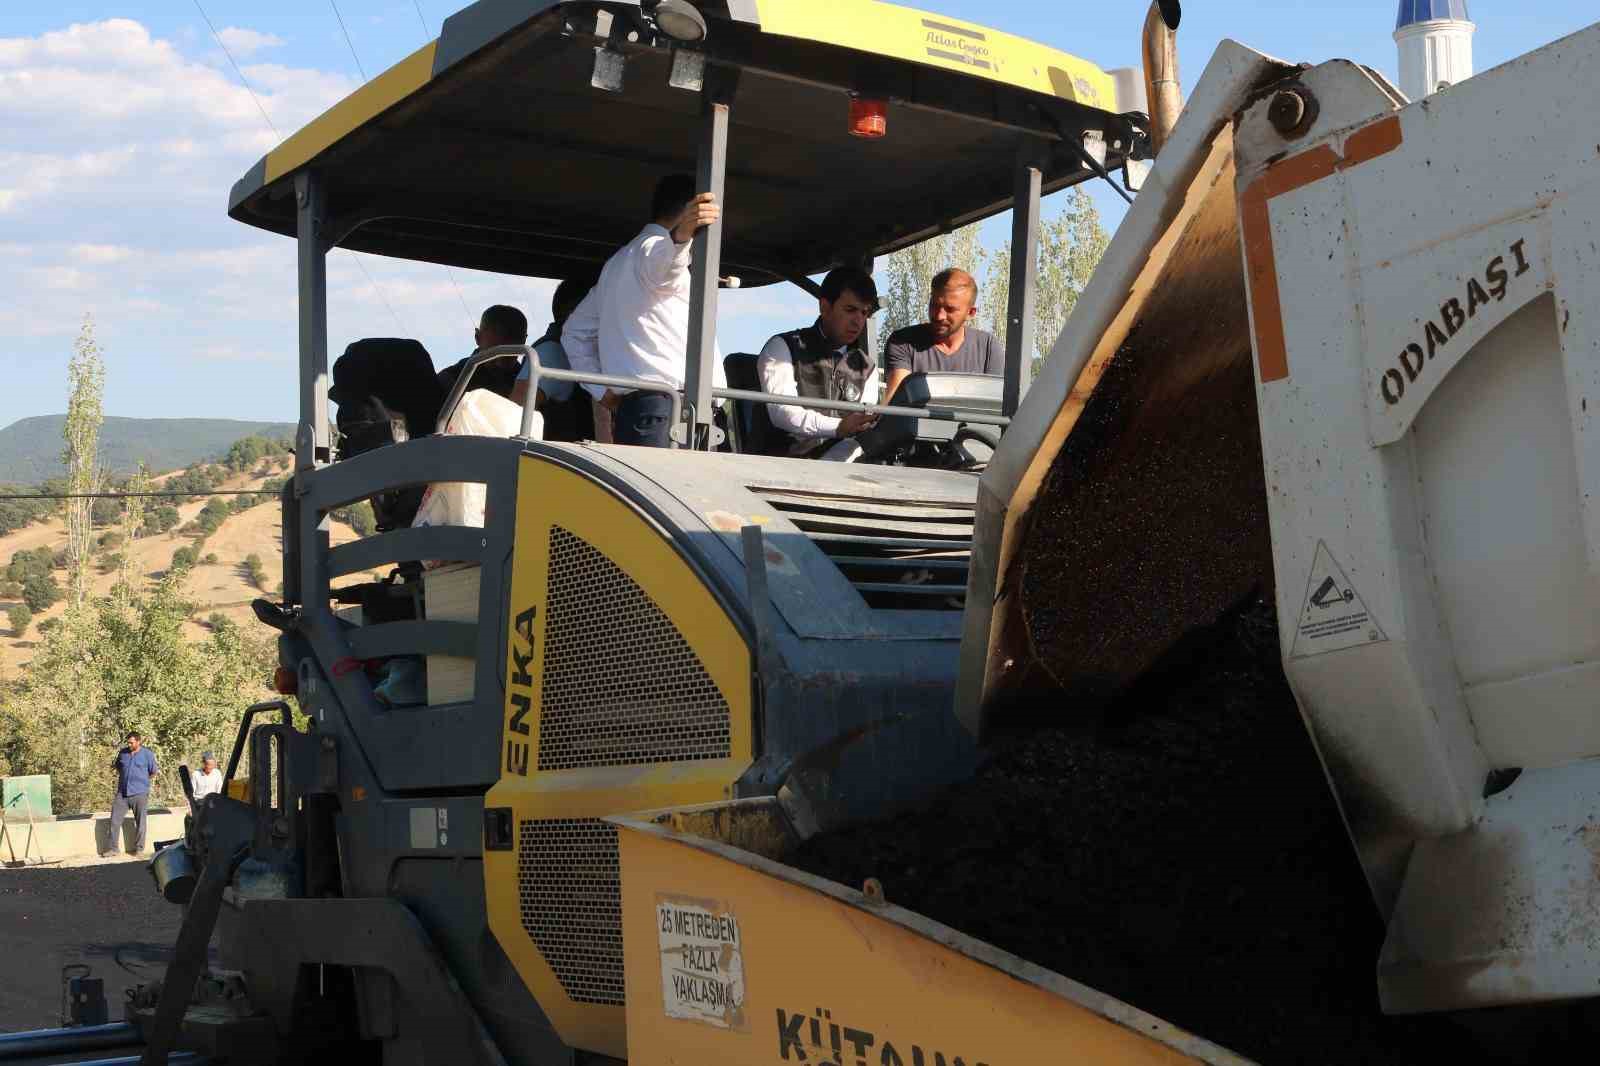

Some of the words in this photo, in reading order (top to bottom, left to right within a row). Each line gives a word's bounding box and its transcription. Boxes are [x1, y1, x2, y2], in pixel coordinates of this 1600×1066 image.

[926, 31, 957, 49] Atlas
[1381, 238, 1530, 405] ODABAŞI
[507, 605, 537, 776] ENKA
[660, 908, 673, 934] 25
[673, 910, 736, 944] METREDEN
[681, 943, 718, 973] FAZLA
